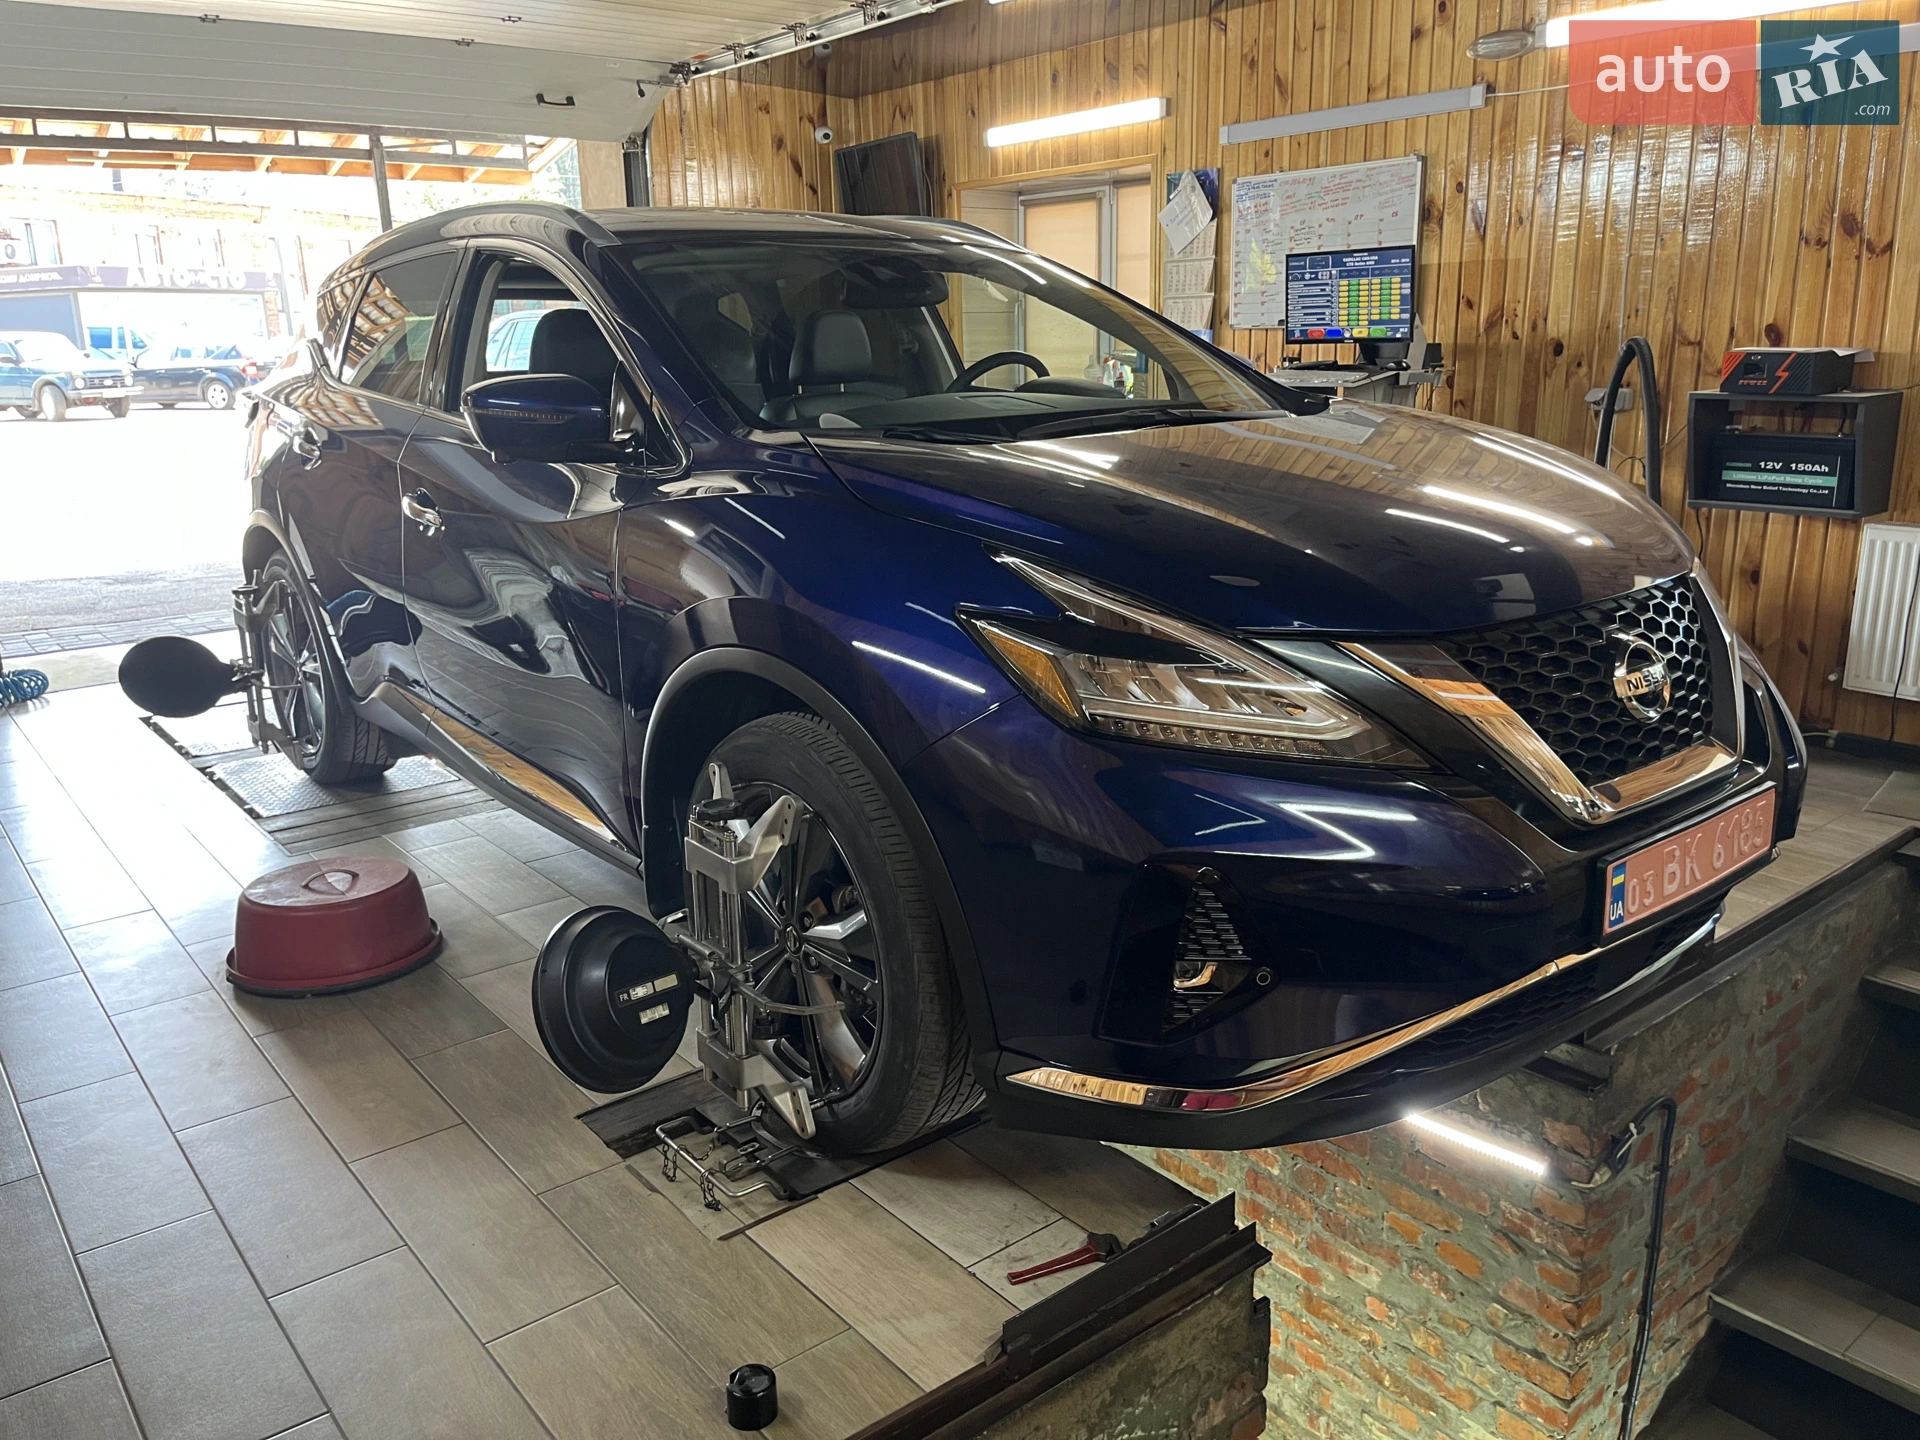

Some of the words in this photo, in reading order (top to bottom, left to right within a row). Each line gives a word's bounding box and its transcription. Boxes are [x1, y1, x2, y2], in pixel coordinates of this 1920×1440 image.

[1759, 461, 1783, 470] 12V
[1789, 462, 1829, 473] 150Ah
[1628, 870, 1655, 914] 03
[1663, 833, 1702, 897] BK
[1712, 800, 1768, 871] 6185
[1610, 901, 1625, 921] UA
[619, 993, 629, 1002] FR
